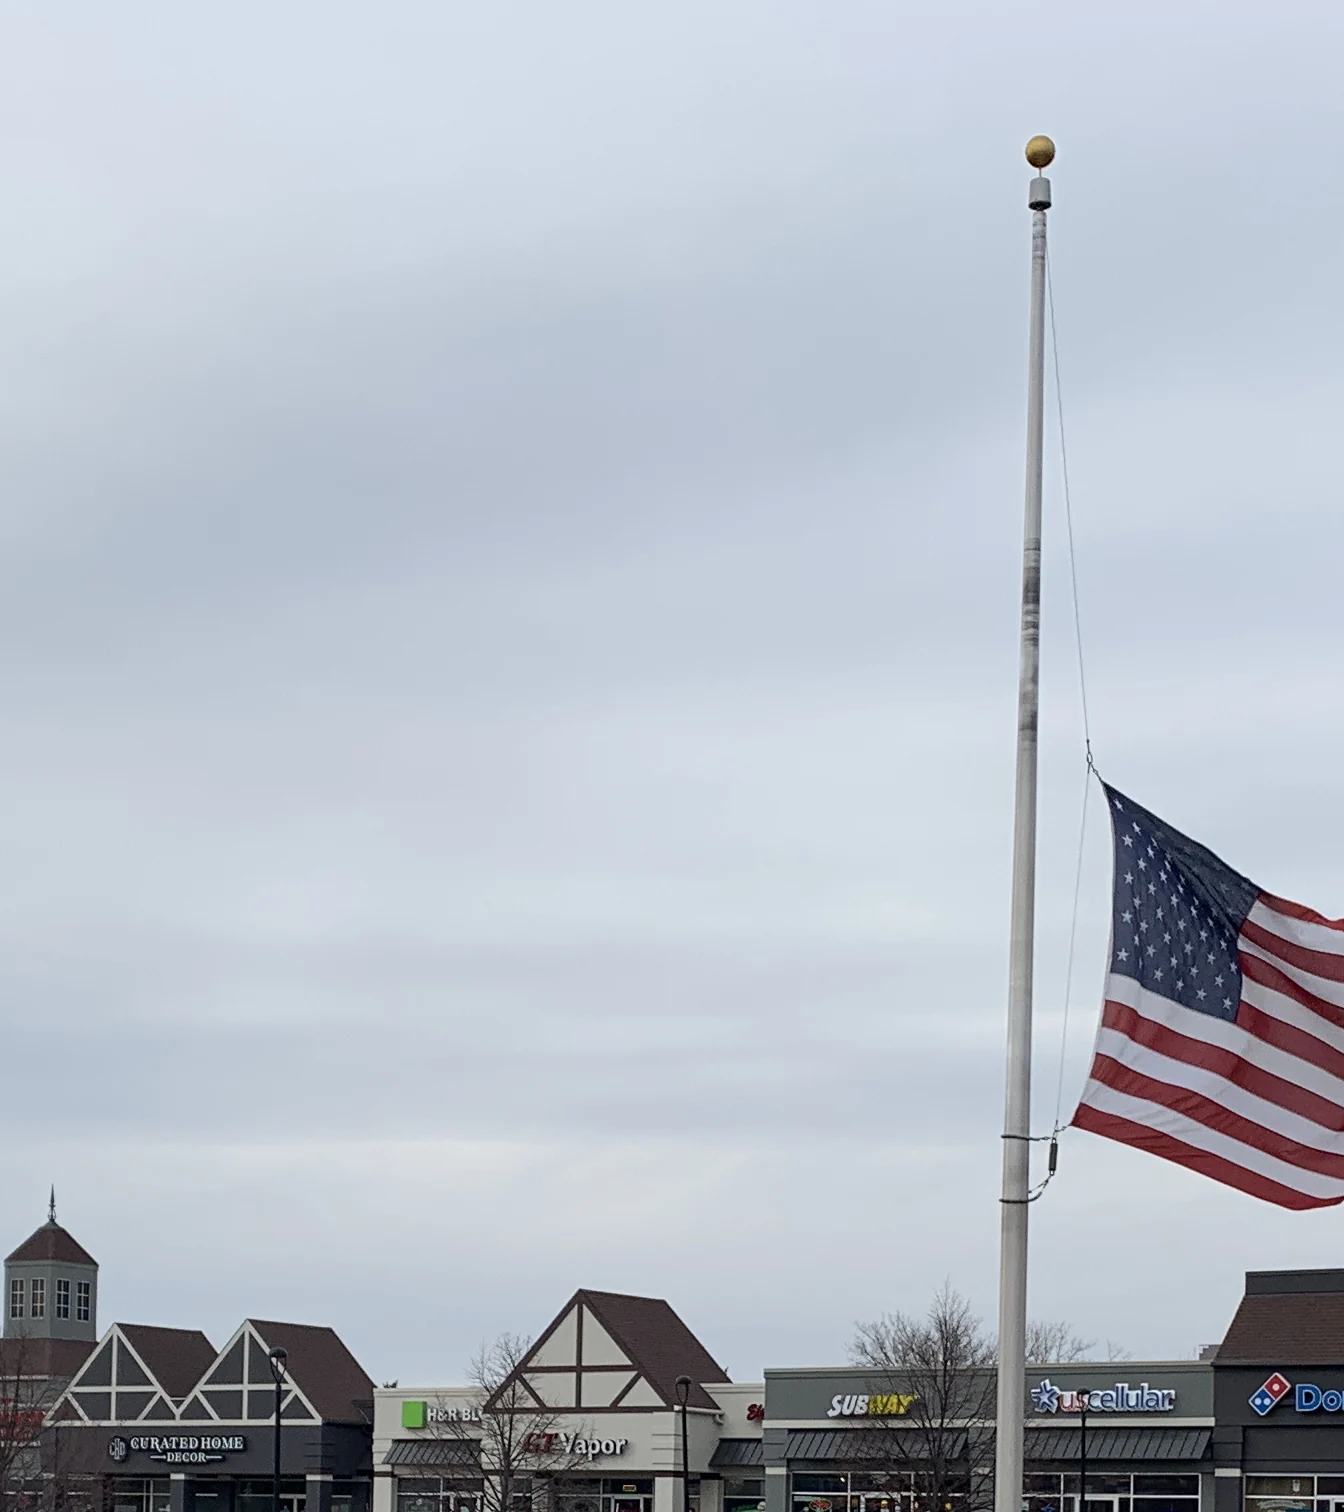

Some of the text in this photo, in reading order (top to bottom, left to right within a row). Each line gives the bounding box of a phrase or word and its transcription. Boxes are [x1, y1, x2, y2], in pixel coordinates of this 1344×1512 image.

[827, 1395, 912, 1418] SUBWAY
[427, 1408, 457, 1421] H&R
[130, 1437, 244, 1452] CURATED HOME
[559, 1433, 627, 1460] Vapor
[167, 1452, 206, 1462] DECOR
